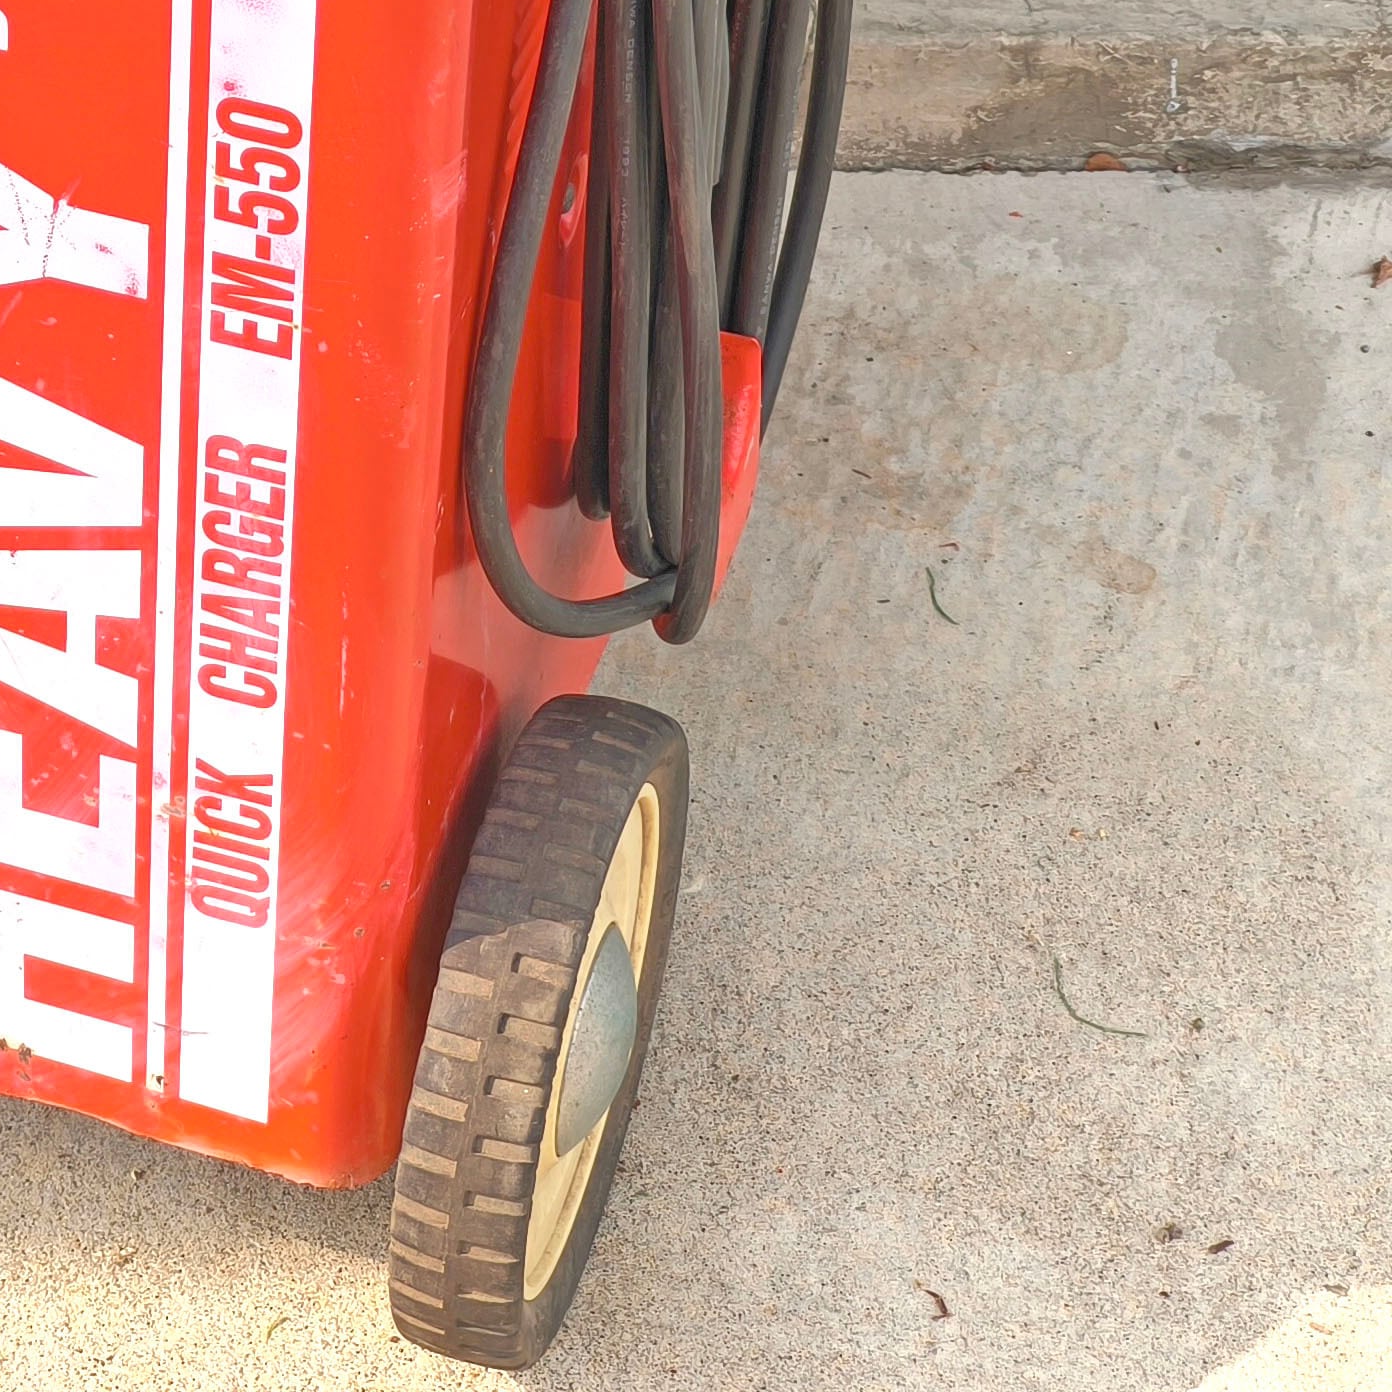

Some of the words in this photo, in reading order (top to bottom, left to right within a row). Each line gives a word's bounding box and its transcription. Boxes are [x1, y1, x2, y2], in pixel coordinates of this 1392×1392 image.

[209, 96, 303, 361] EM-550
[198, 434, 288, 709] CHARGER
[192, 758, 274, 929] QUICK
